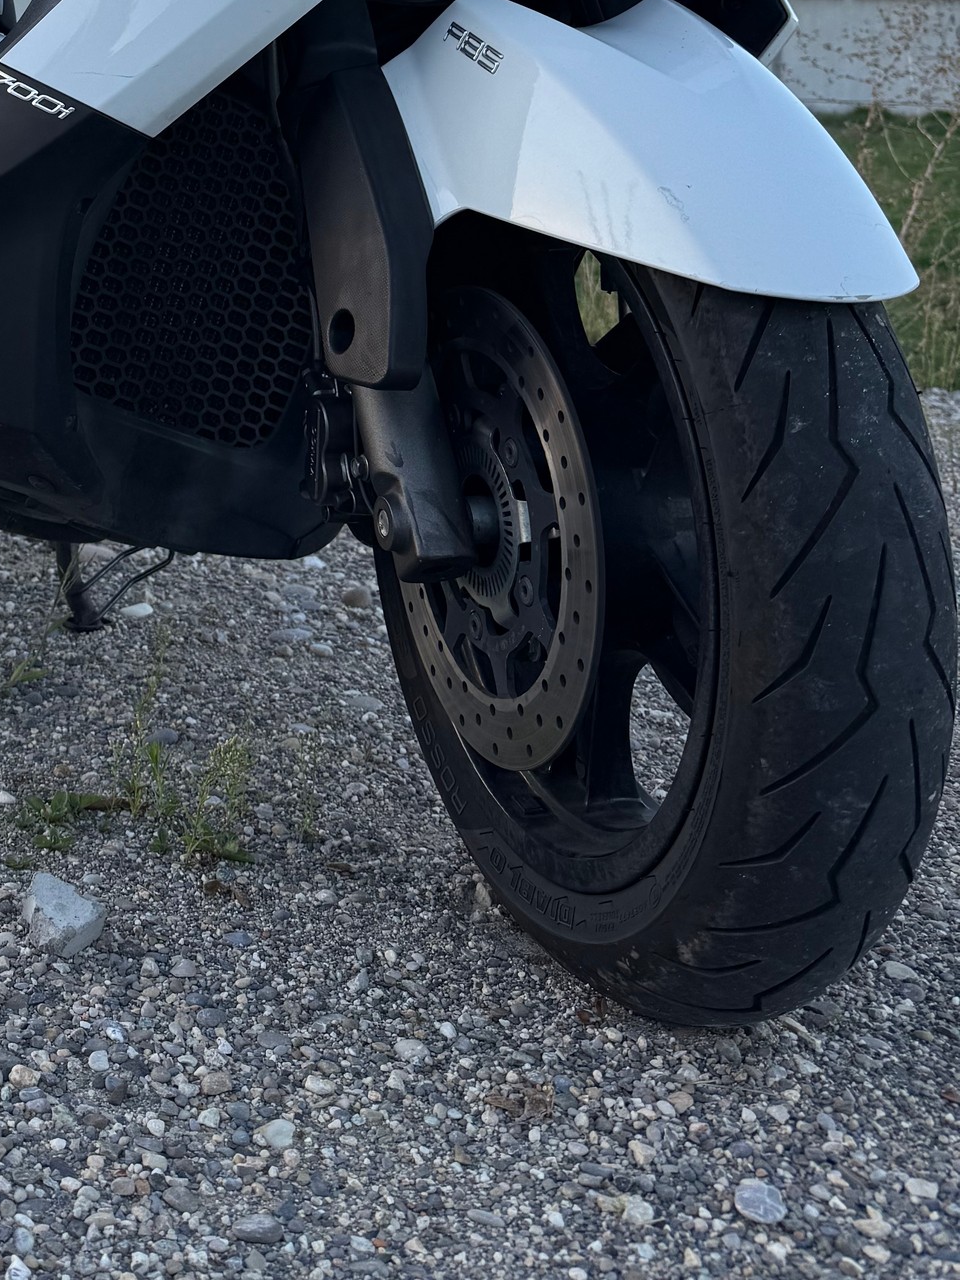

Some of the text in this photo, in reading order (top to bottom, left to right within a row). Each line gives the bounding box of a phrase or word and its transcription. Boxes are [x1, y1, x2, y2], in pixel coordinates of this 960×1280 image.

[443, 21, 505, 75] ABS
[411, 696, 468, 816] ROSSO
[488, 847, 577, 931] DIABLO
